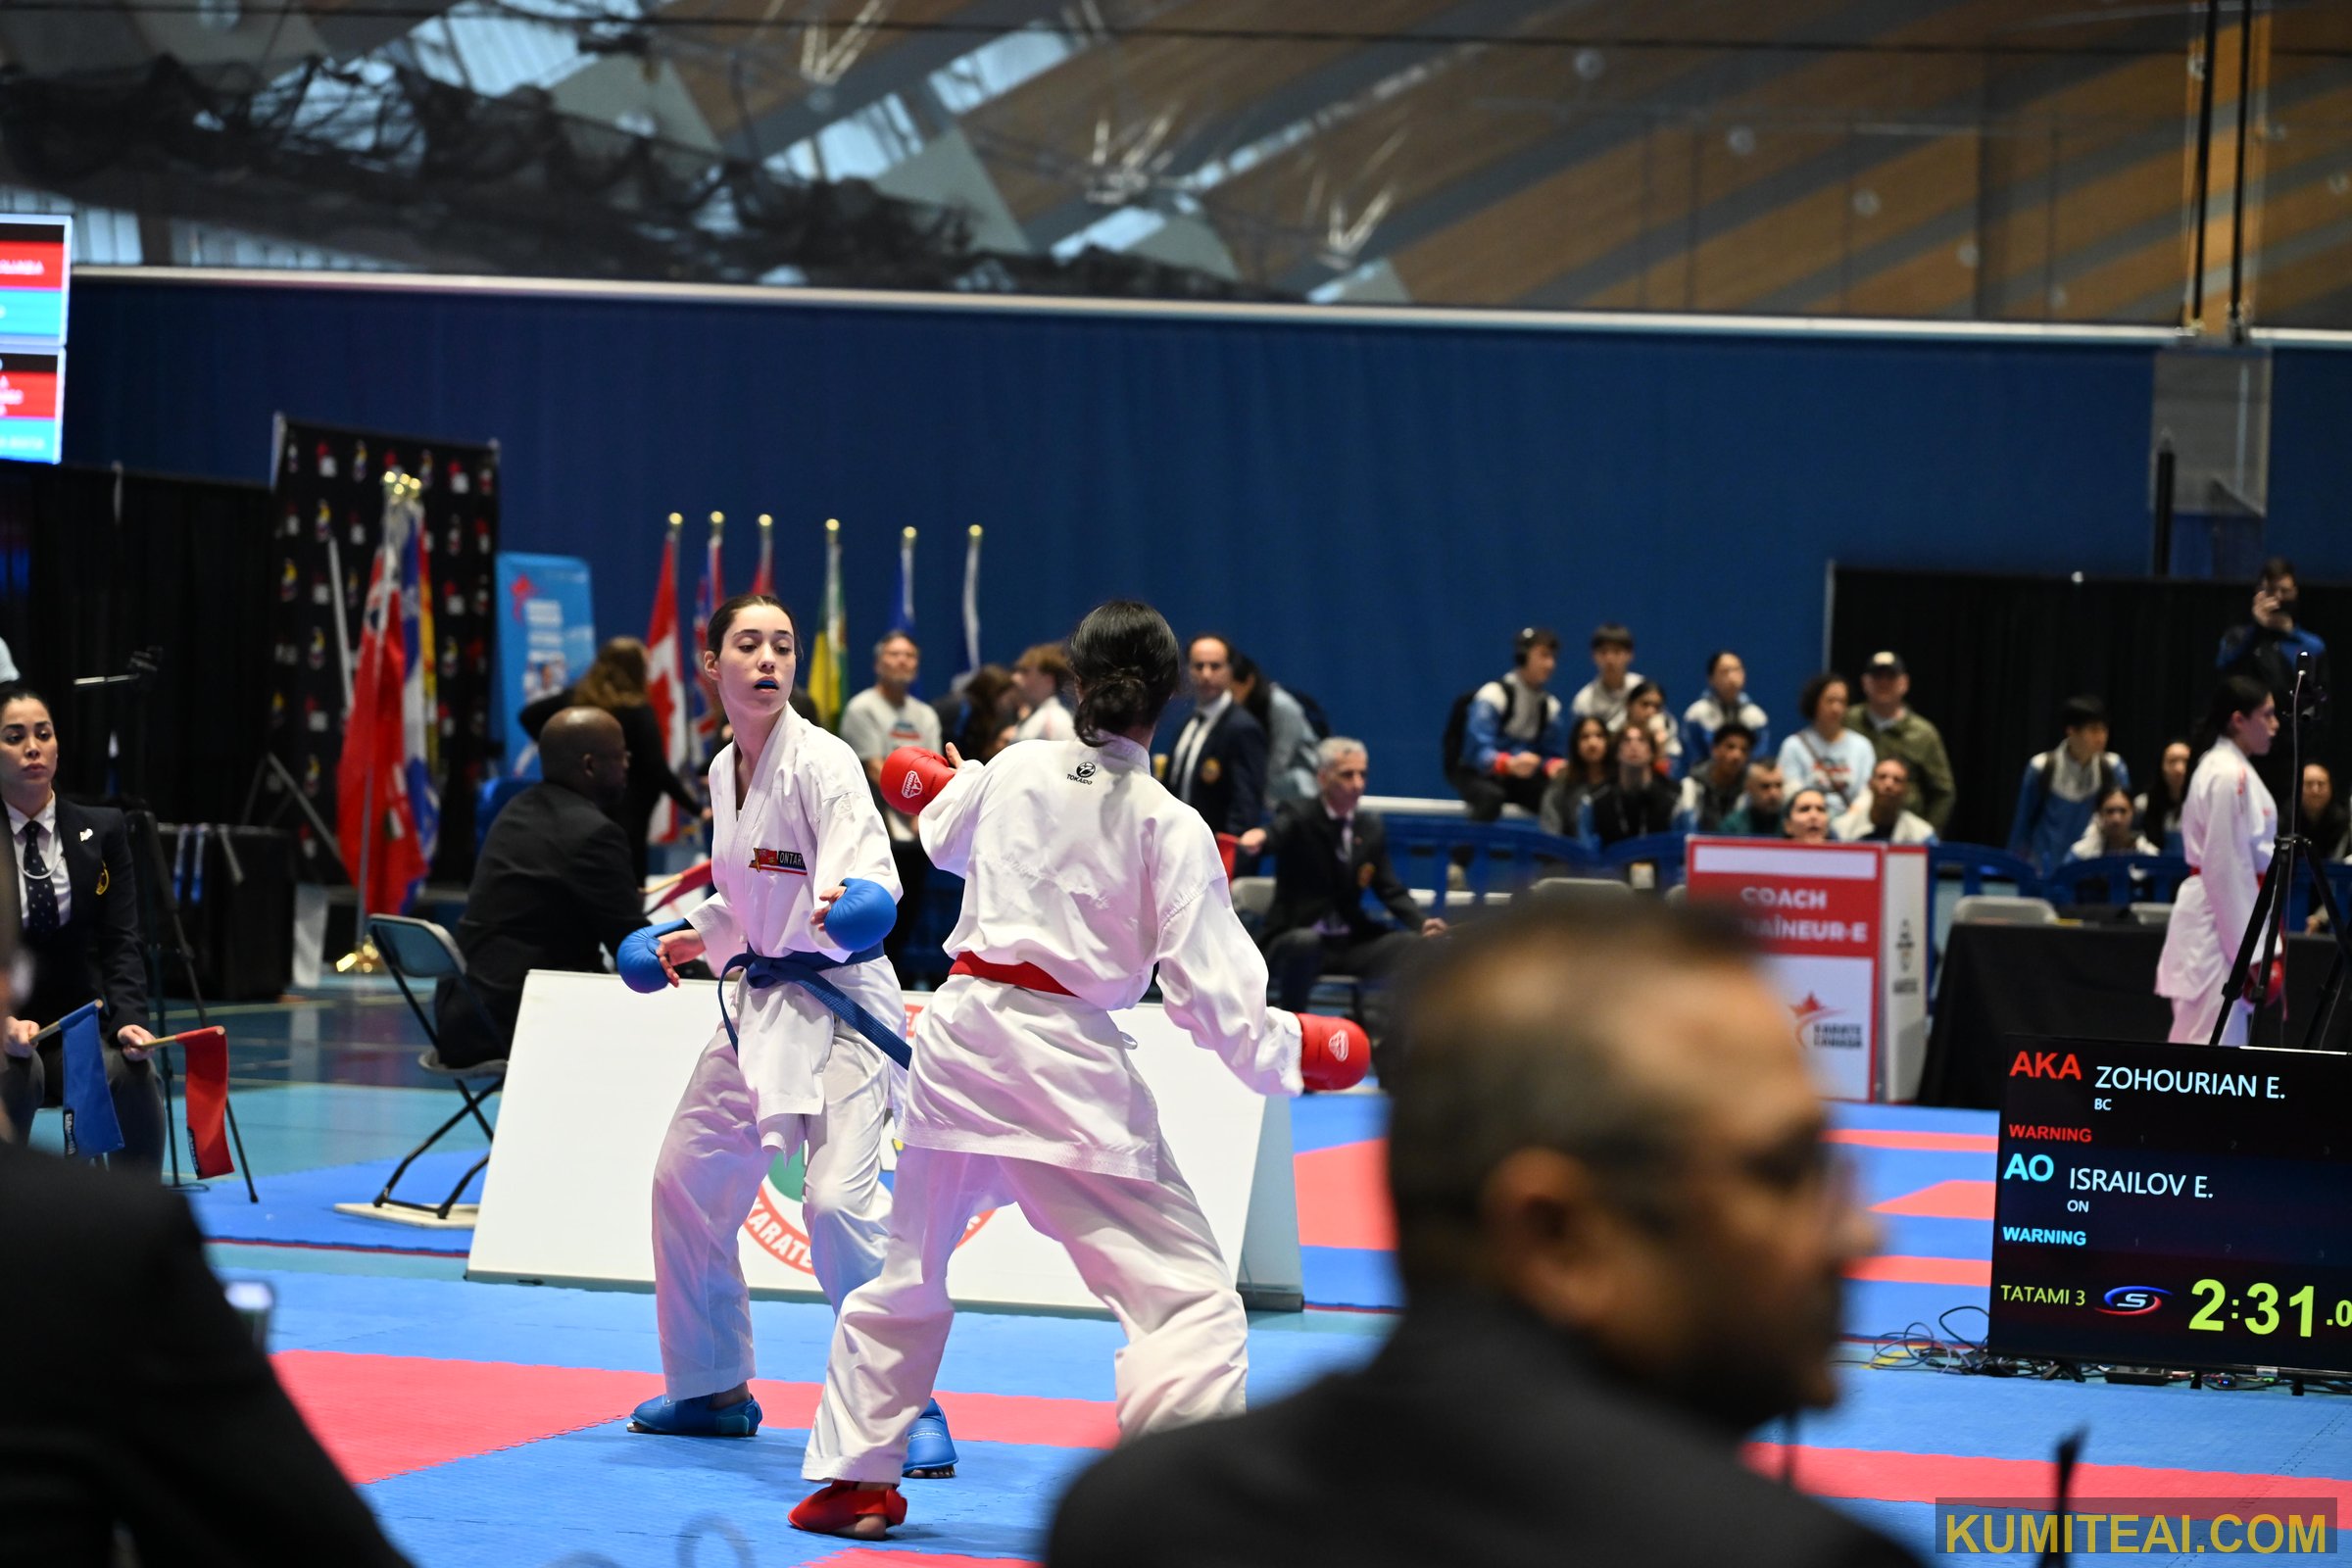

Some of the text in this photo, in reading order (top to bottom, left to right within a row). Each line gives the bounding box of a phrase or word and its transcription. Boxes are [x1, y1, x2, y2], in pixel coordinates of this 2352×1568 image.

[1066, 773, 1093, 785] TOKAIDO
[780, 852, 804, 866] ONTAR
[1740, 886, 1827, 909] COACH
[2009, 1051, 2082, 1080] AKA
[2094, 1065, 2285, 1100] ZOHOURIAN E.
[2094, 1099, 2112, 1111] BC
[2009, 1124, 2092, 1143] WARNING
[2004, 1153, 2054, 1182] AO
[2069, 1168, 2214, 1199] ISRAILOV E.
[2067, 1200, 2089, 1213] ON
[2002, 1227, 2086, 1246] WARNING
[2001, 1285, 2085, 1306] TATAMI 3
